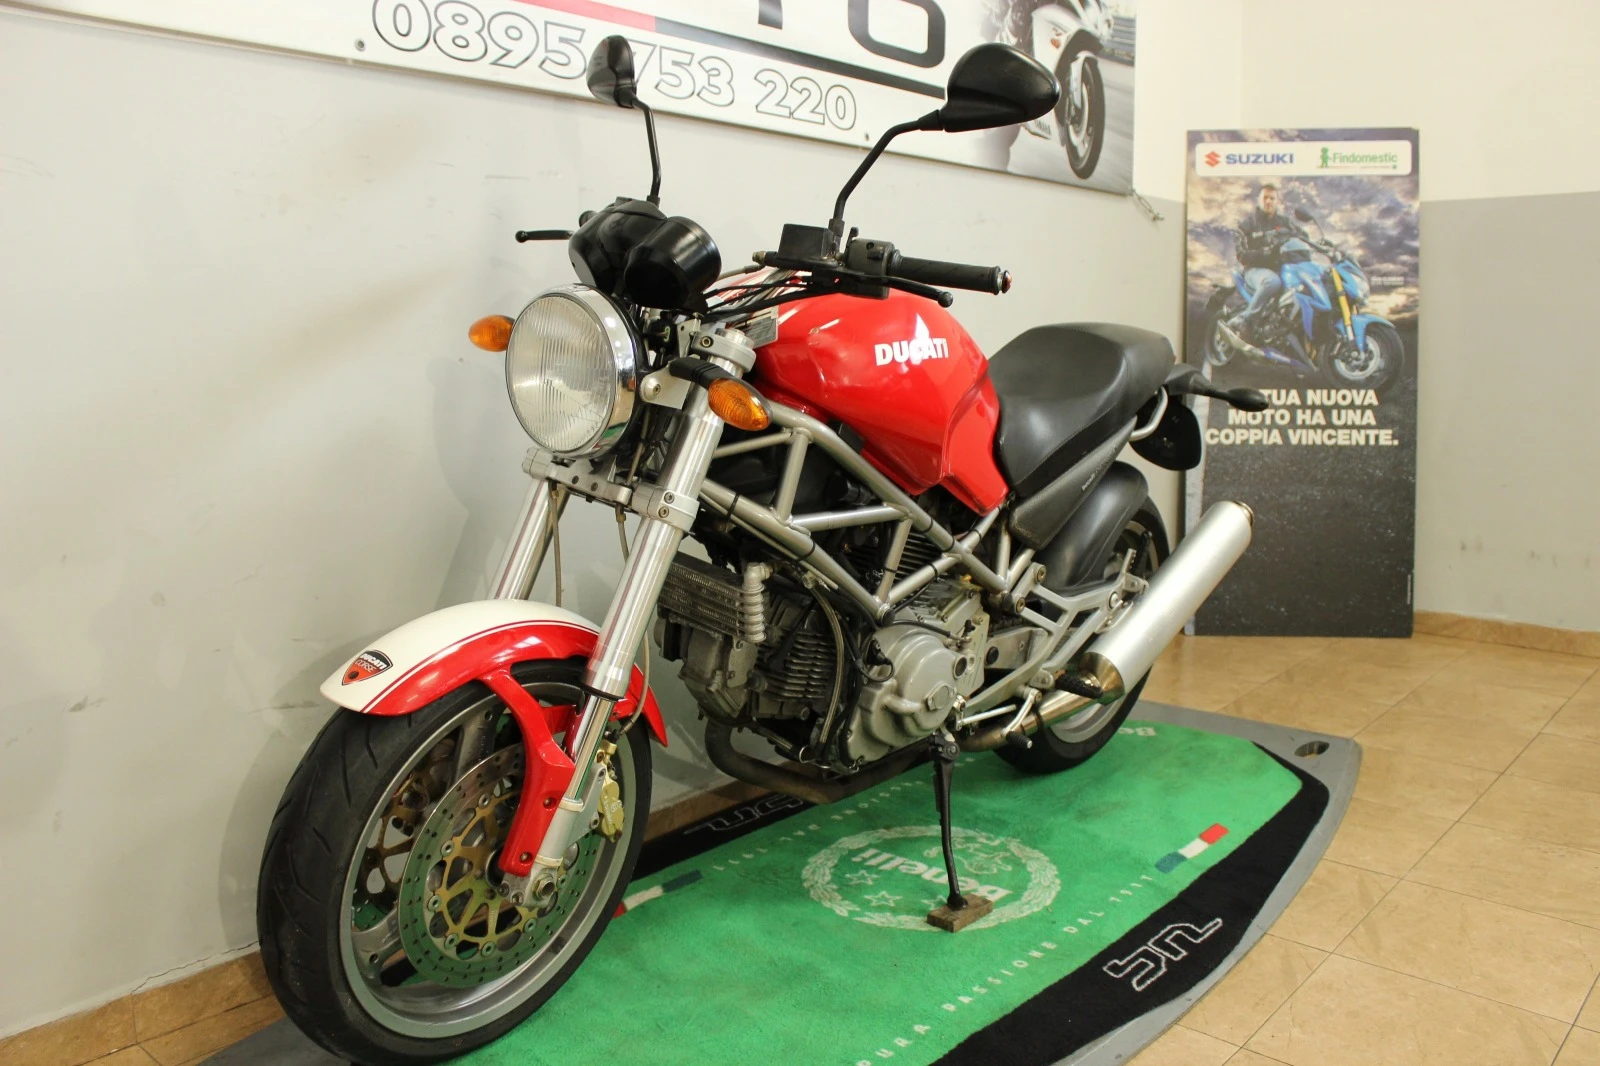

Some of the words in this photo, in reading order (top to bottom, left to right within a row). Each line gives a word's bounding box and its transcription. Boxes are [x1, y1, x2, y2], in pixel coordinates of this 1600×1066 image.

[372, 0, 587, 79] 0895
[754, 68, 857, 130] 220
[1225, 153, 1294, 164] SUZUKI
[1332, 152, 1398, 163] Findomestic
[874, 338, 949, 366] DUCATI
[1307, 389, 1379, 405] NUOVA
[1228, 409, 1291, 425] MOTO
[1296, 409, 1326, 425] HA
[1331, 409, 1376, 425] UNA
[1205, 428, 1283, 445] COPPIA
[1288, 429, 1399, 445] VINCENTE.
[941, 939, 1058, 1013] PASSIONE
[1063, 910, 1104, 934] DAL
